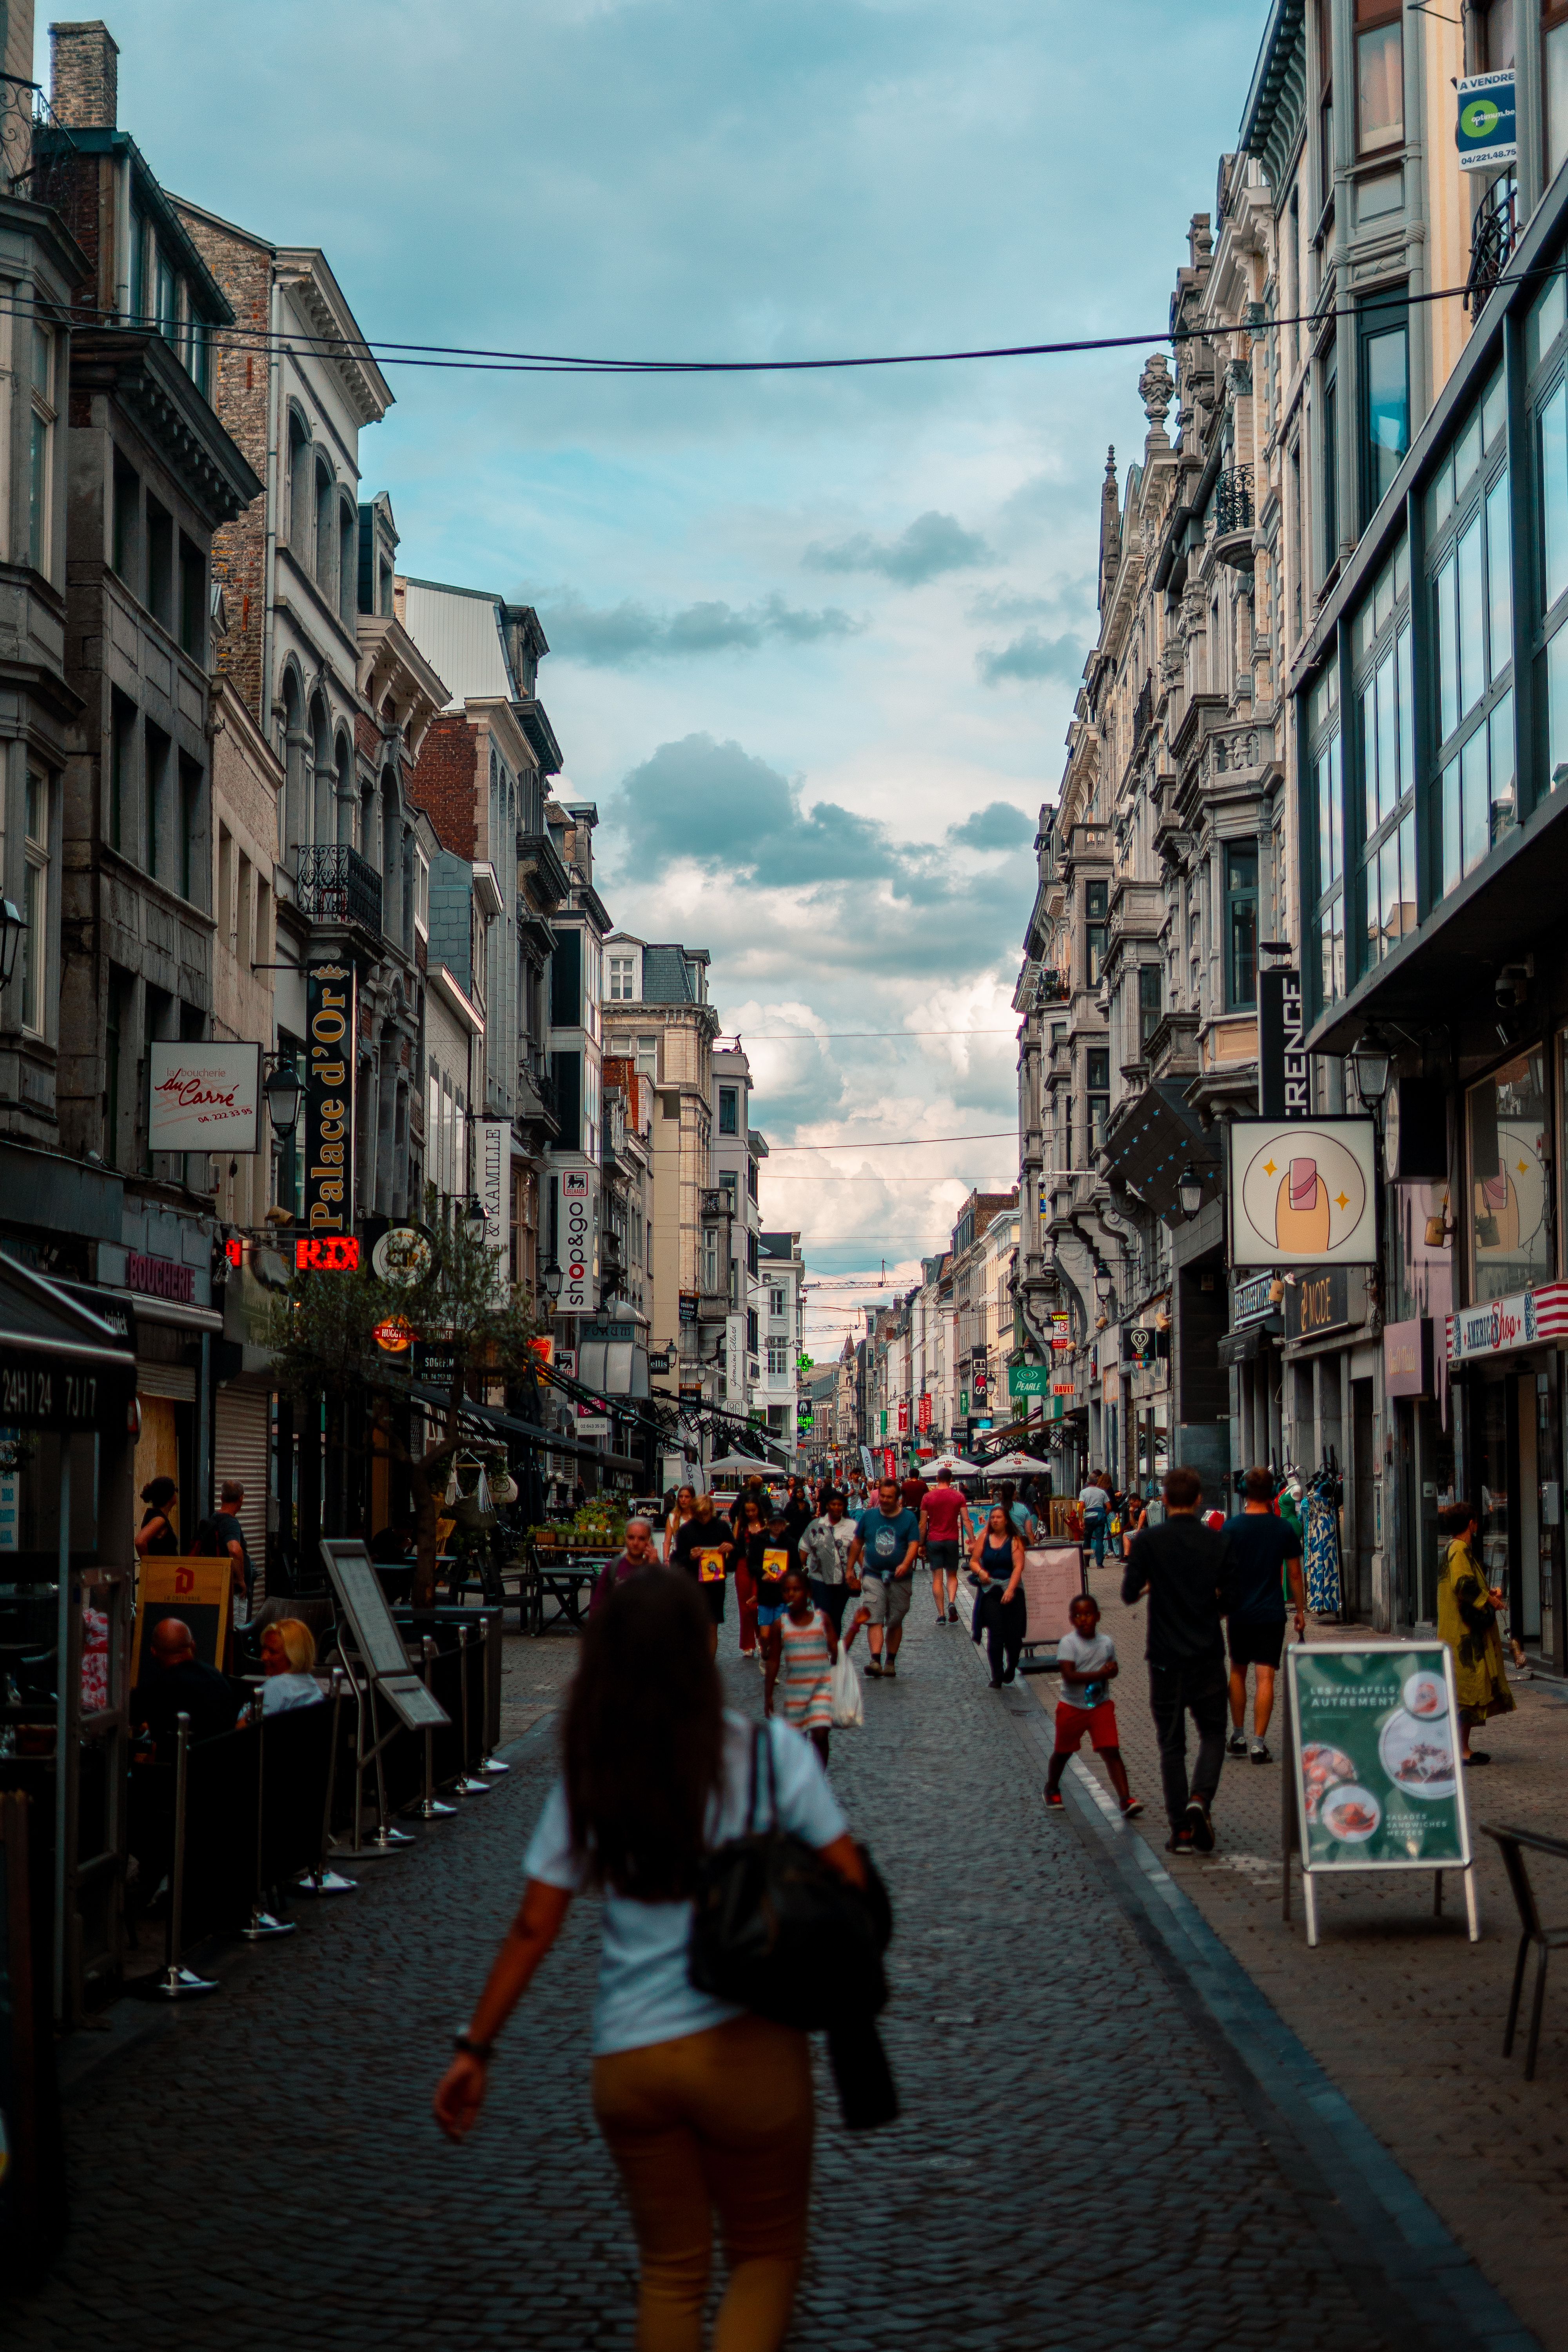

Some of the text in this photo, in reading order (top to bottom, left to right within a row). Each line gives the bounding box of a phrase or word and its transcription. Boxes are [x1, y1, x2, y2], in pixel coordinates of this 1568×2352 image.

[1460, 72, 1515, 90] A VENDRE
[1471, 109, 1515, 126] optimum.be
[1461, 149, 1516, 165] 04/221.48.75
[1282, 978, 1307, 1116] RENCE
[167, 1068, 226, 1076] la boucherie
[154, 1068, 240, 1107] du Carré
[310, 987, 346, 1231] Palace d'Or
[485, 1129, 501, 1216] KAMILLE
[485, 1222, 500, 1236] &
[564, 1202, 588, 1305] shop&go
[129, 1252, 195, 1302] BOUCHERIE
[1309, 1276, 1331, 1327] MODE
[381, 1328, 408, 1338] HUGGY'S
[1467, 1302, 1516, 1350] AMERICAN Shop
[1015, 1381, 1041, 1391] PEARLE
[1310, 1686, 1331, 1695] LES
[1387, 1820, 1447, 1829] SANDWICHES
